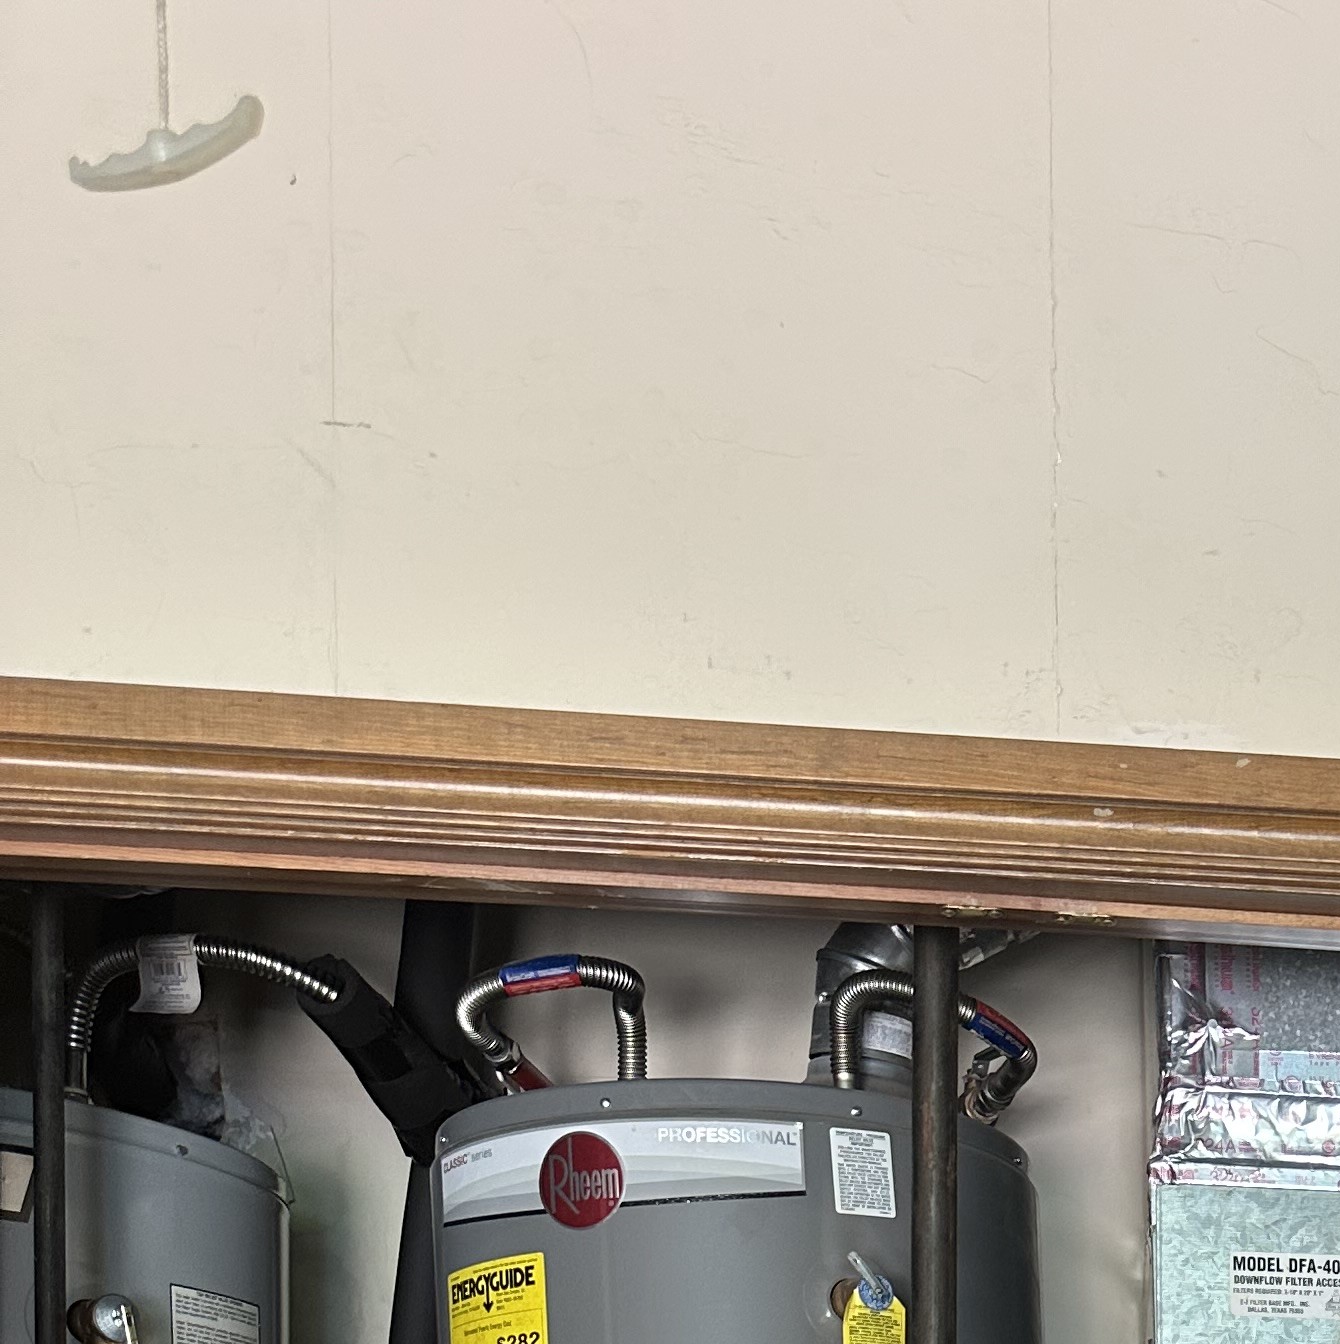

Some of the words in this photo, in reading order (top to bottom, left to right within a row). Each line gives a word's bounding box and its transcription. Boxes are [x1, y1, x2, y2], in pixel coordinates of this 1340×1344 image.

[657, 1126, 797, 1148] PROFESSIONAL
[550, 1136, 620, 1216] Rheem
[1233, 1255, 1284, 1273] MODEL
[451, 1264, 536, 1306] ENERGYGUIDE
[1233, 1274, 1283, 1286] DOWNFLOW
[1285, 1276, 1314, 1287] FILTER
